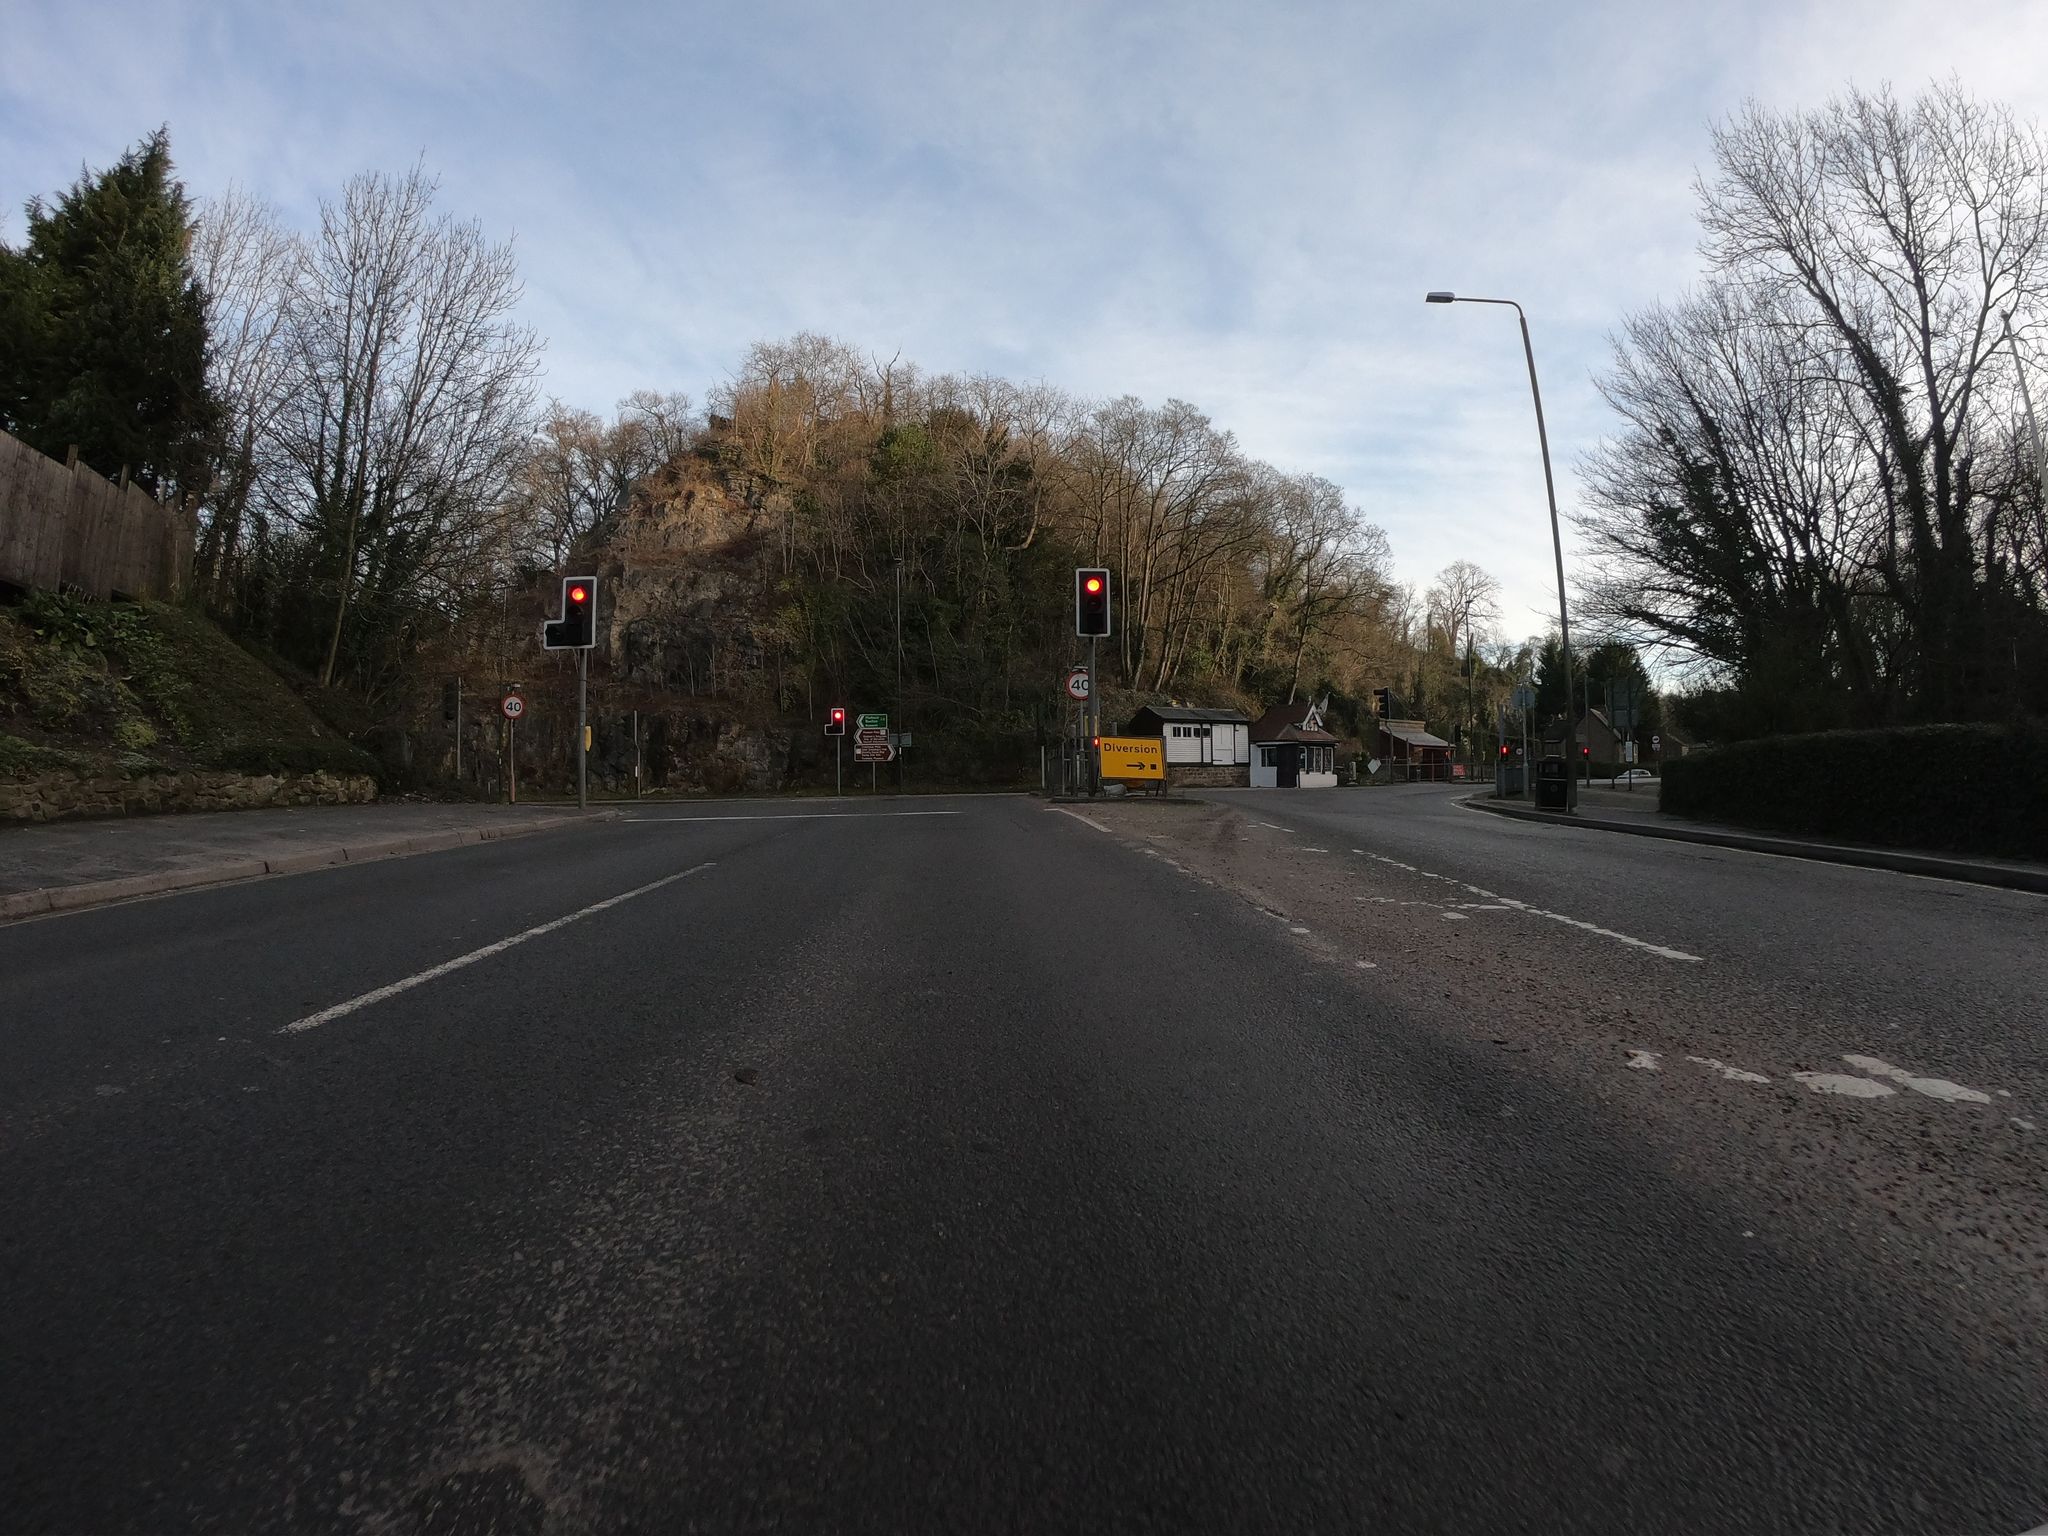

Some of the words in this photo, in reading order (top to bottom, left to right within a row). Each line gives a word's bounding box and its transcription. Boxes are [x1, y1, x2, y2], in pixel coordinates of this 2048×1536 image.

[1071, 679, 1089, 691] 40
[506, 702, 521, 712] 40
[1104, 743, 1158, 754] Diversion
